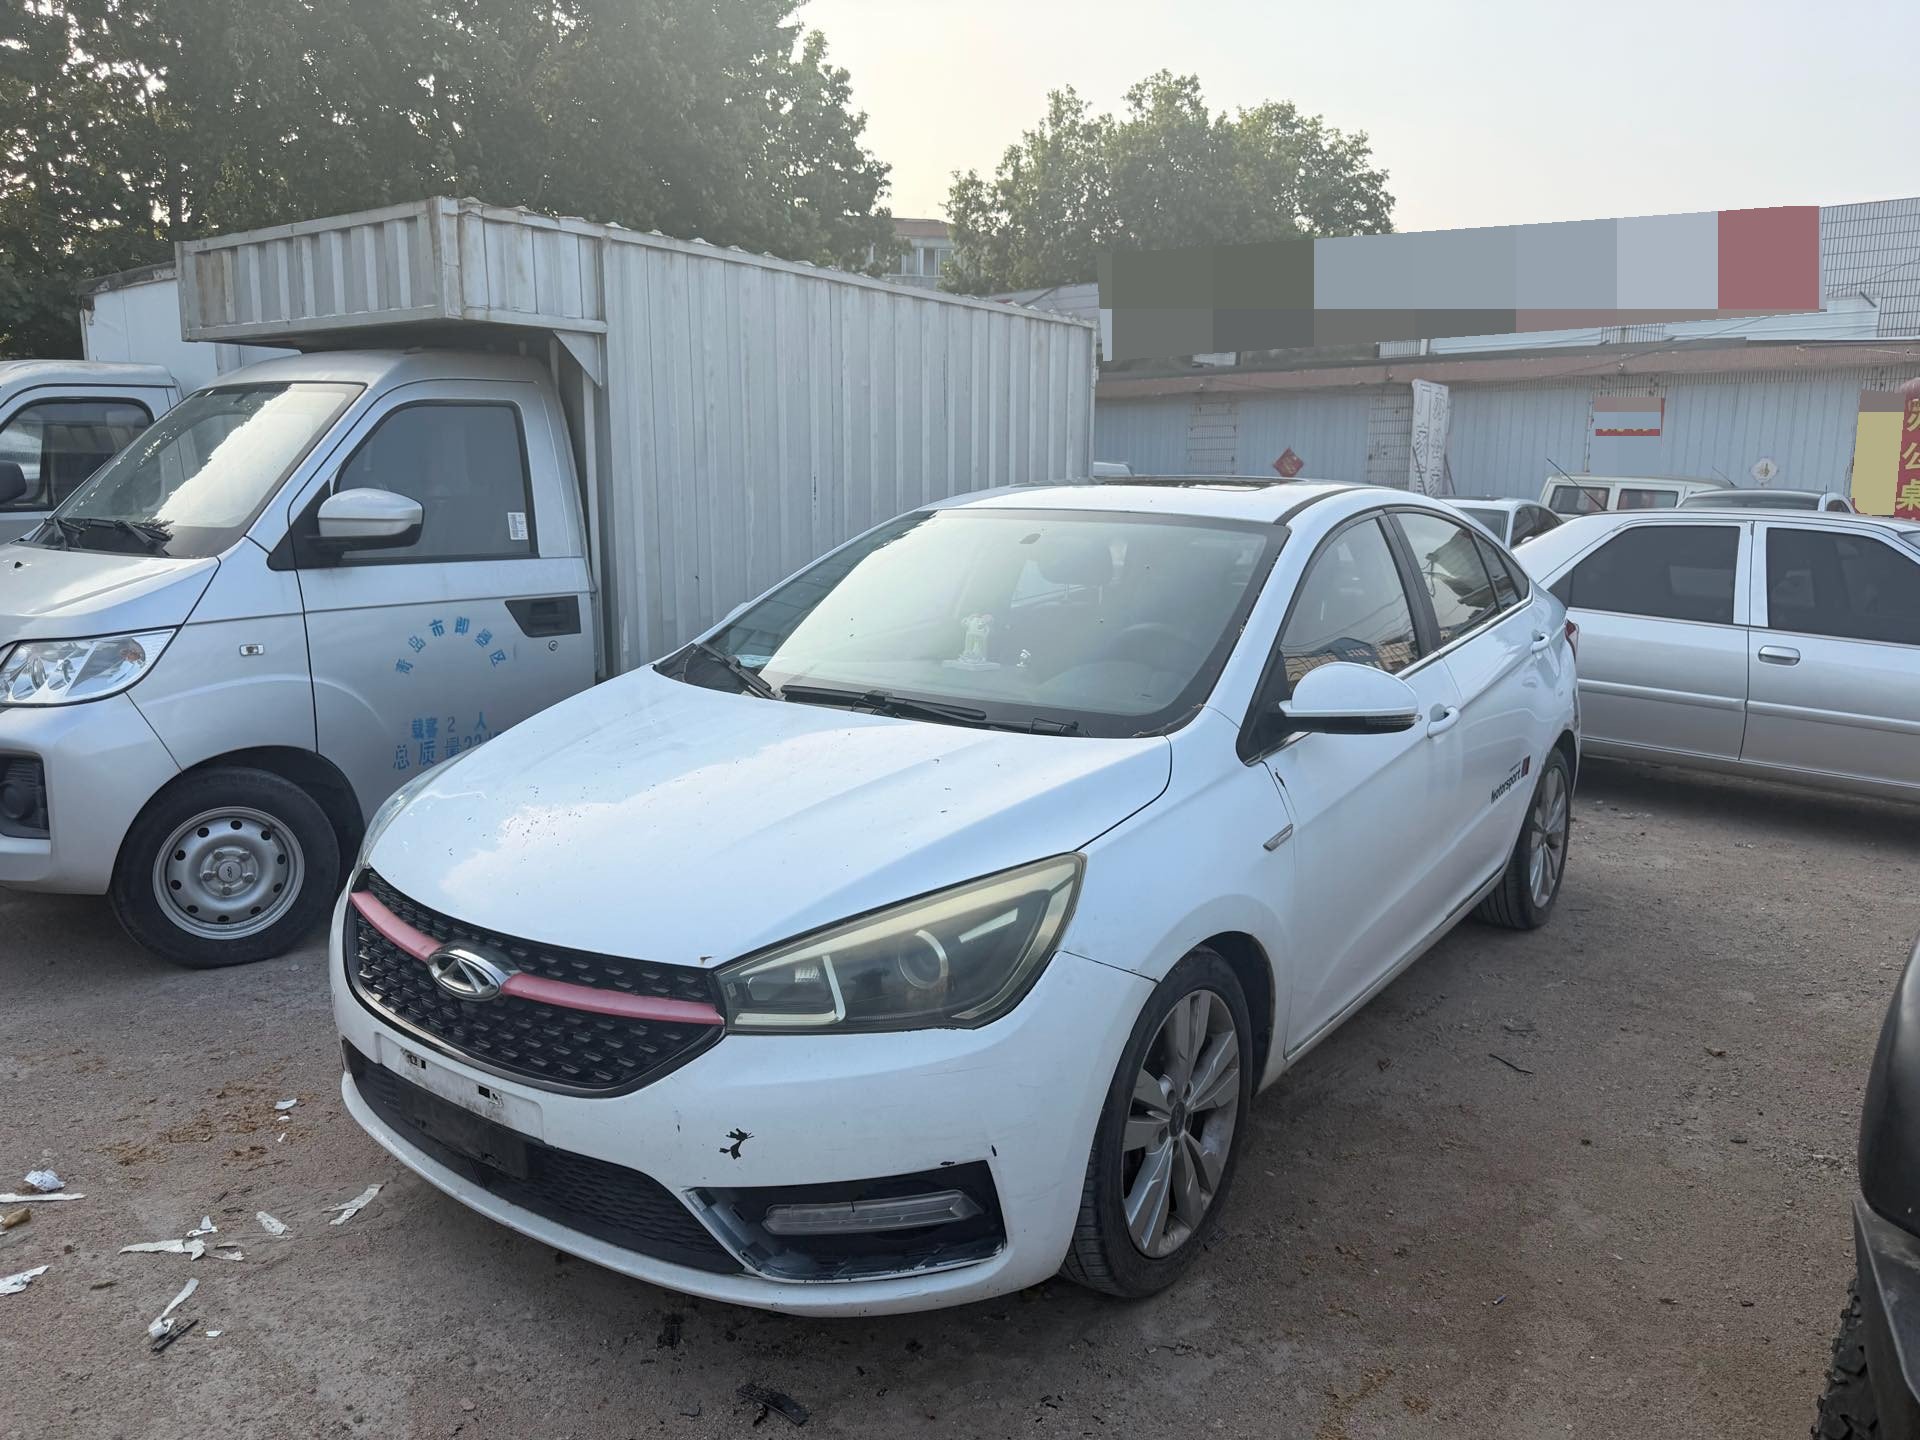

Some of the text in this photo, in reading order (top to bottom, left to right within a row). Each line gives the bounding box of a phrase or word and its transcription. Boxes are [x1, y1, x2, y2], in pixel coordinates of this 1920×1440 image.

[395, 616, 506, 673] 青岛市即墨区
